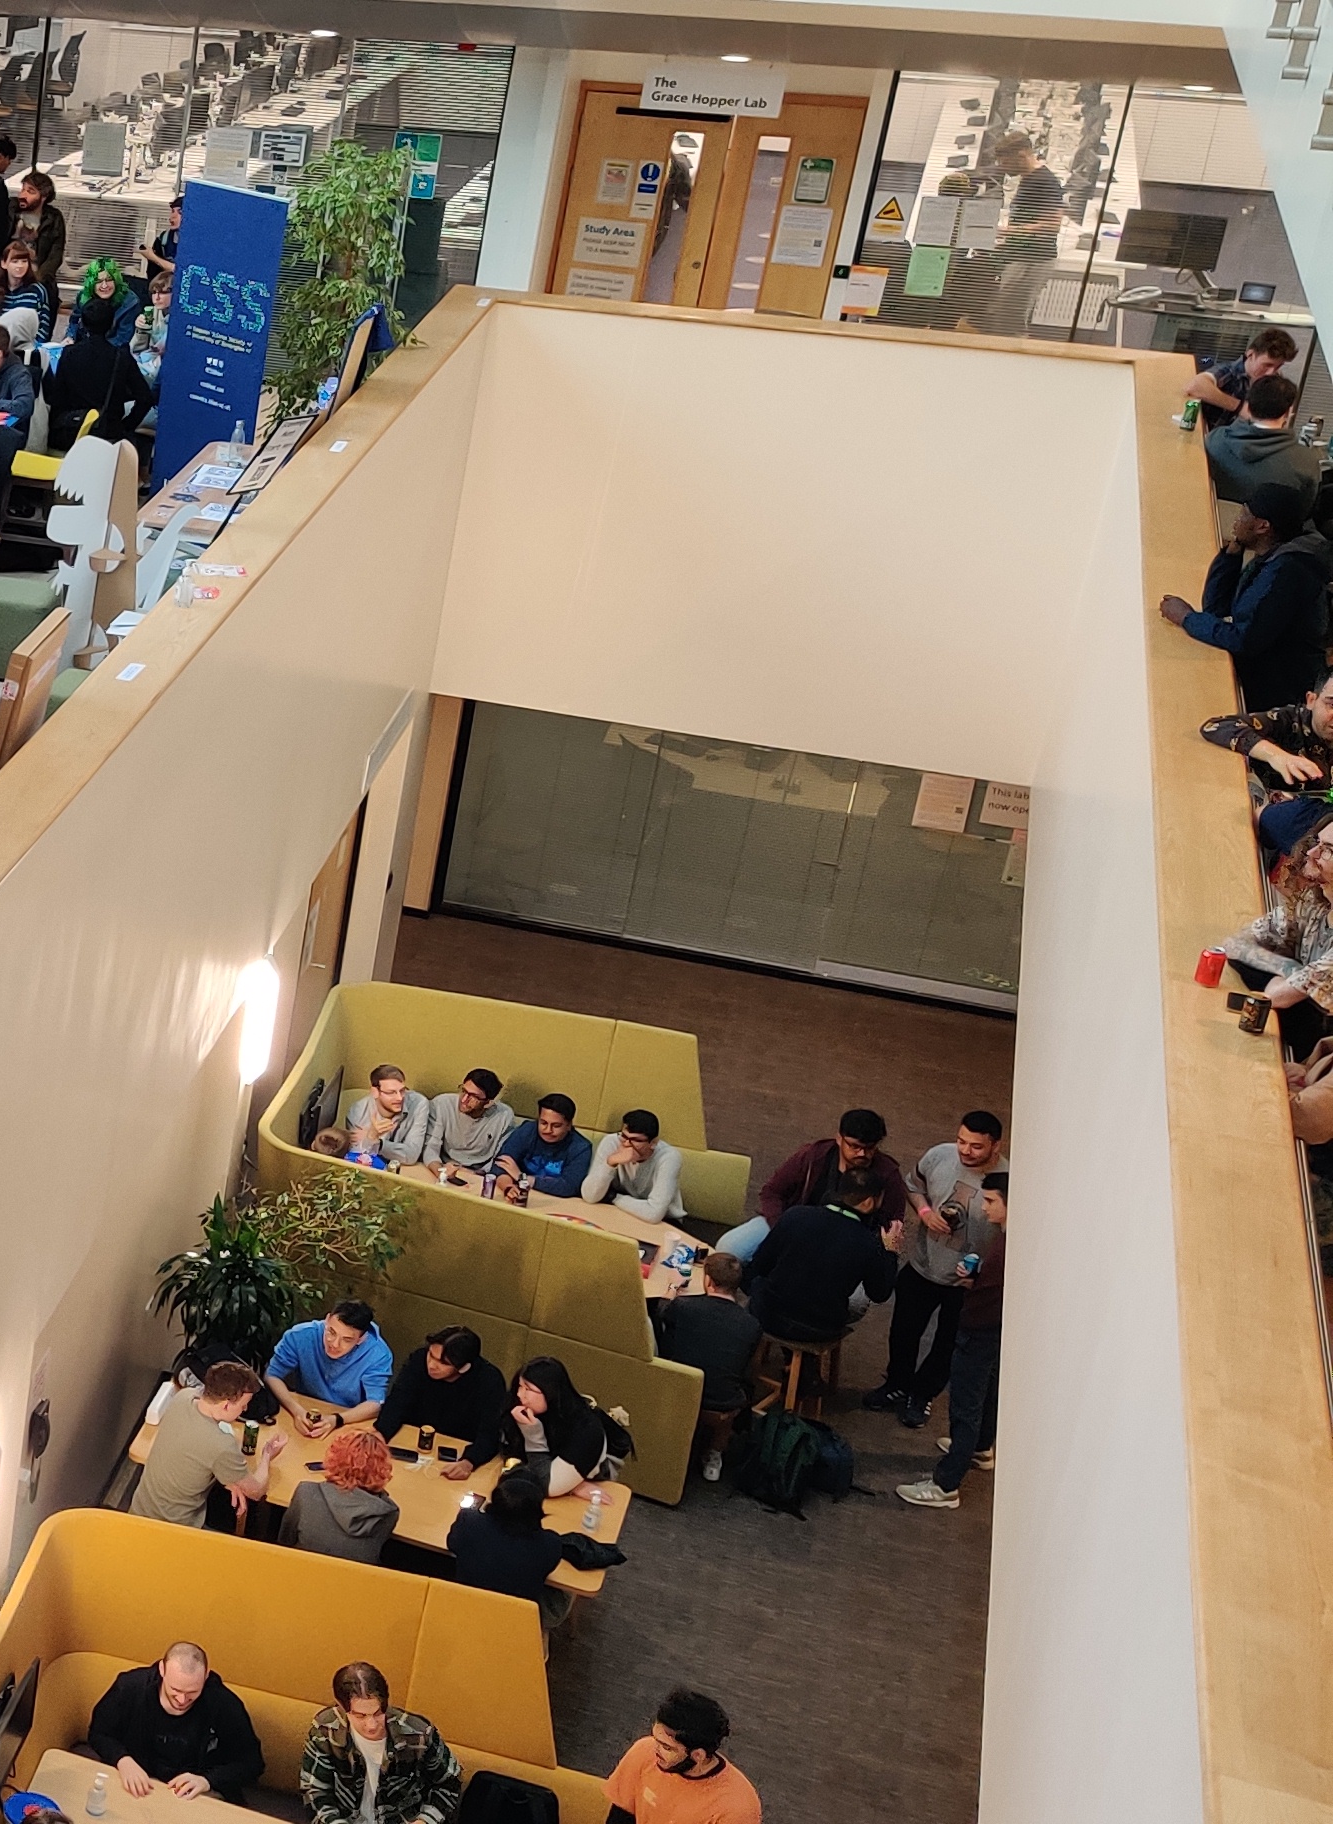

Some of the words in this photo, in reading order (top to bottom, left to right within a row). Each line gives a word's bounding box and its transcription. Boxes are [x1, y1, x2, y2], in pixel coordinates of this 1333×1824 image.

[654, 76, 677, 89] The
[651, 90, 689, 104] Grace
[692, 93, 741, 109] Hopper
[744, 97, 768, 109] Lab
[584, 224, 611, 237] Study
[613, 227, 635, 238] Area
[179, 264, 270, 334] CSS
[988, 802, 1011, 811] now
